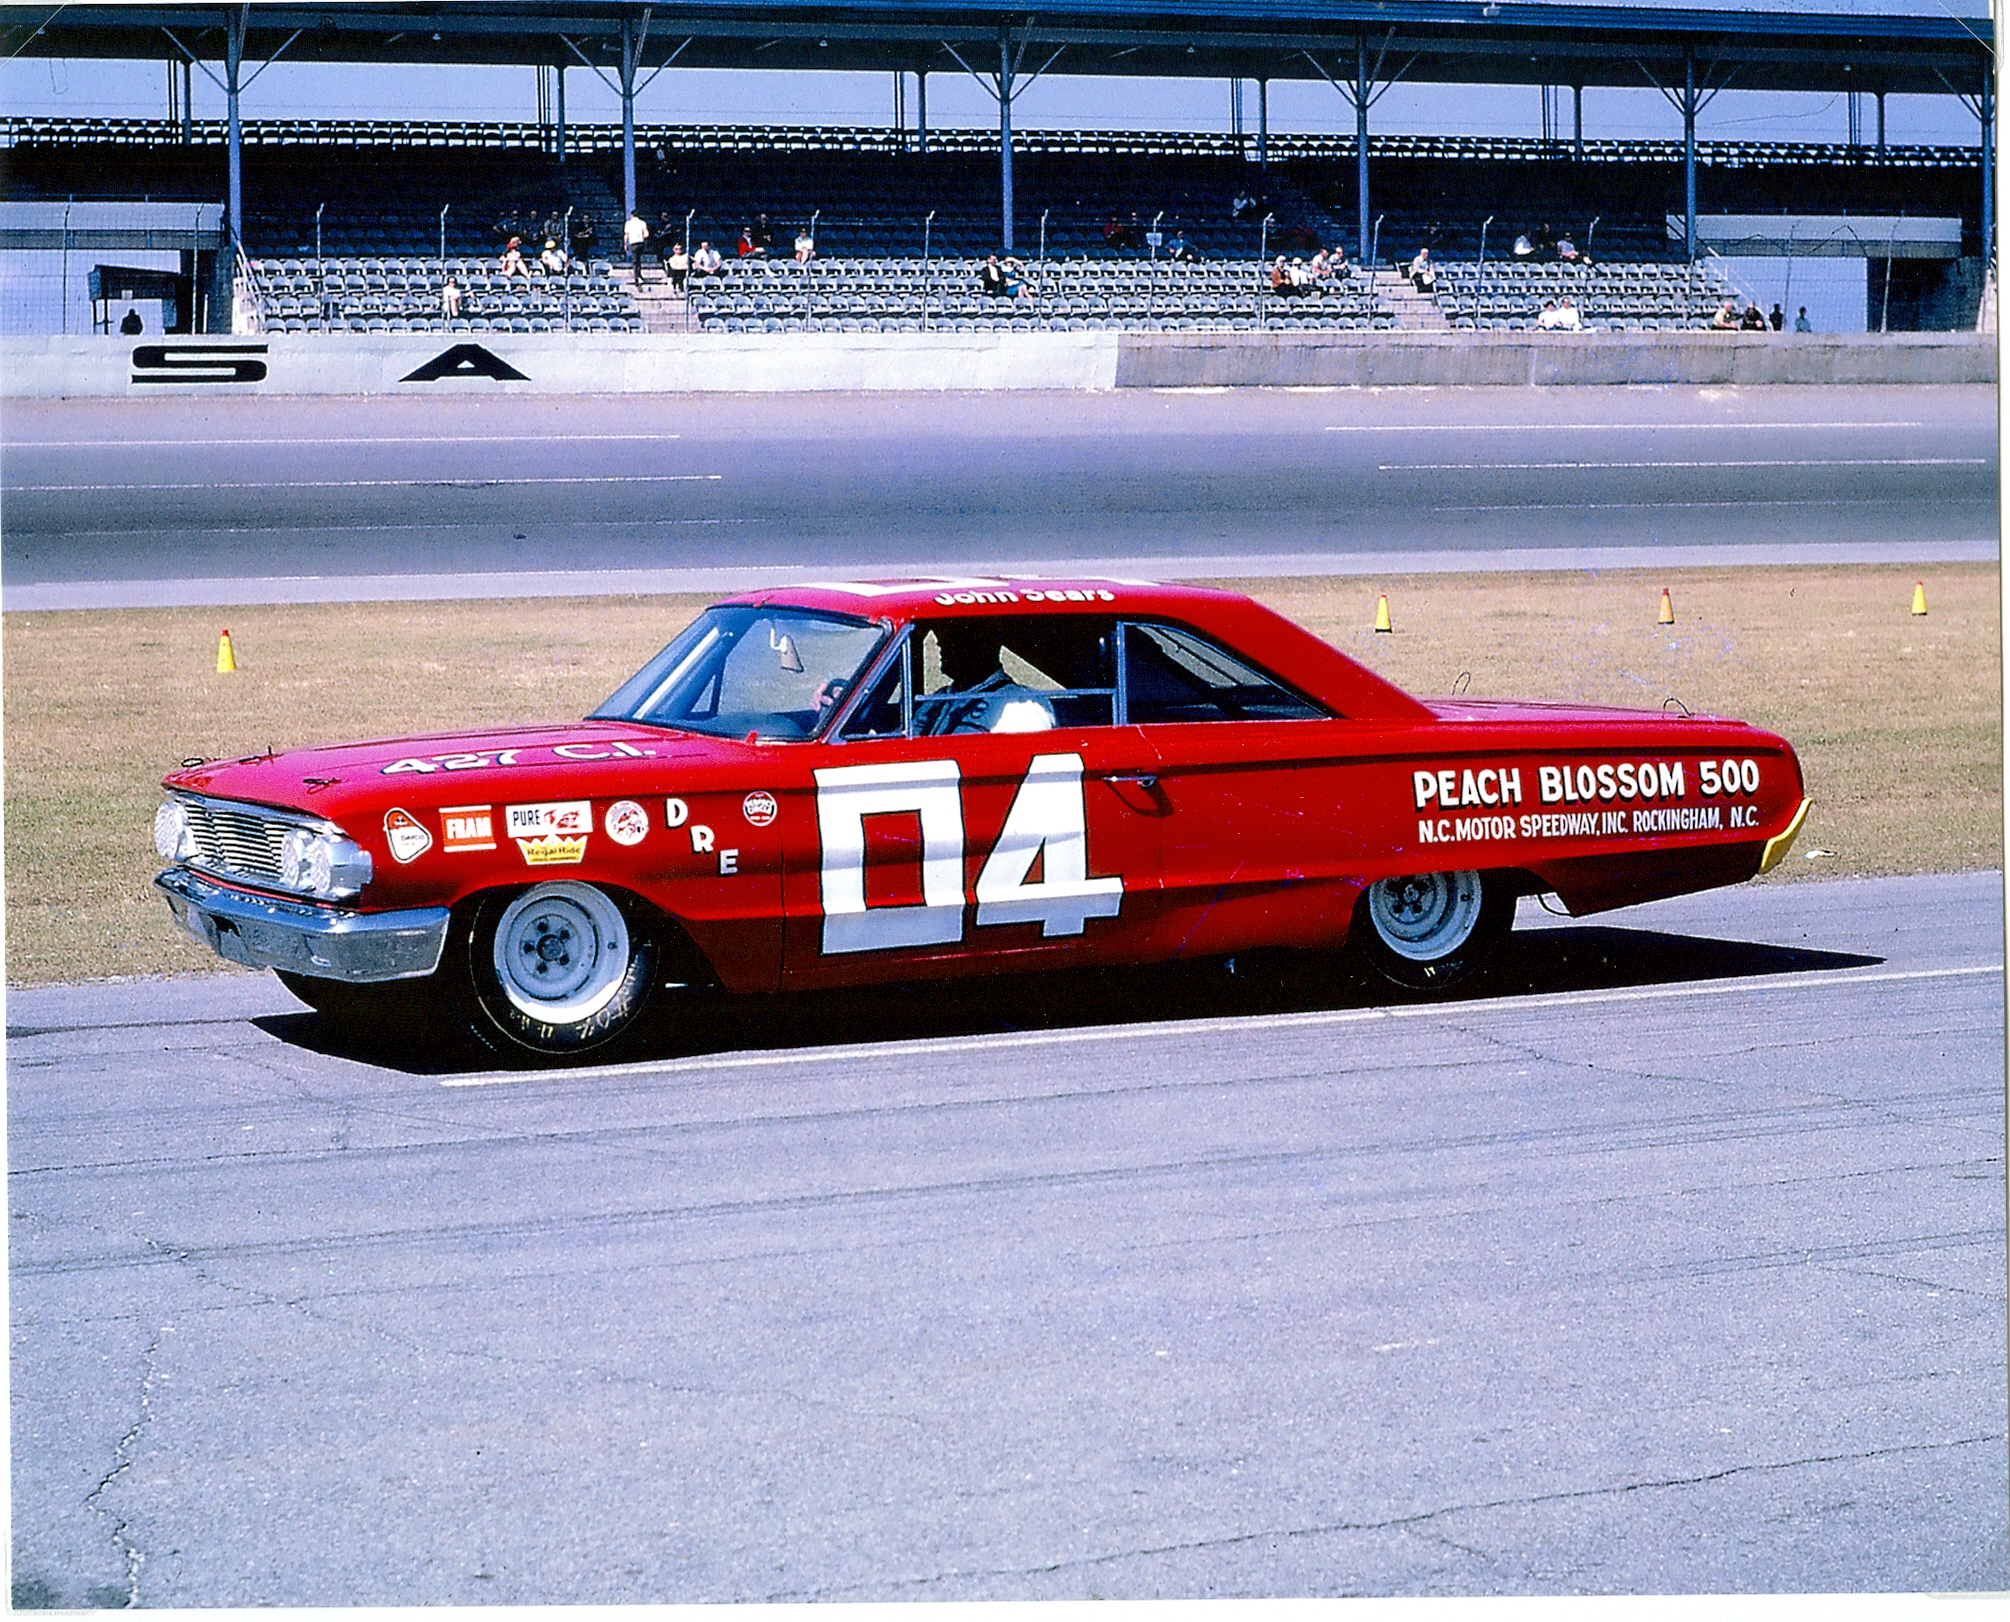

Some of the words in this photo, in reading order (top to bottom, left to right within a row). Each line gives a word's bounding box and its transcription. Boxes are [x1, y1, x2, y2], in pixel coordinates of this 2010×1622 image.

[934, 590, 1019, 606] John
[1019, 588, 1115, 602] Sears
[380, 749, 523, 775] 427
[1413, 768, 1522, 808] PEACH
[1539, 762, 1685, 806] BLOSSOM
[1699, 759, 1760, 798] 500
[513, 809, 541, 827] PURE
[1730, 805, 1760, 828] N.C.
[446, 817, 491, 840] FRAM
[814, 752, 1124, 955] 04
